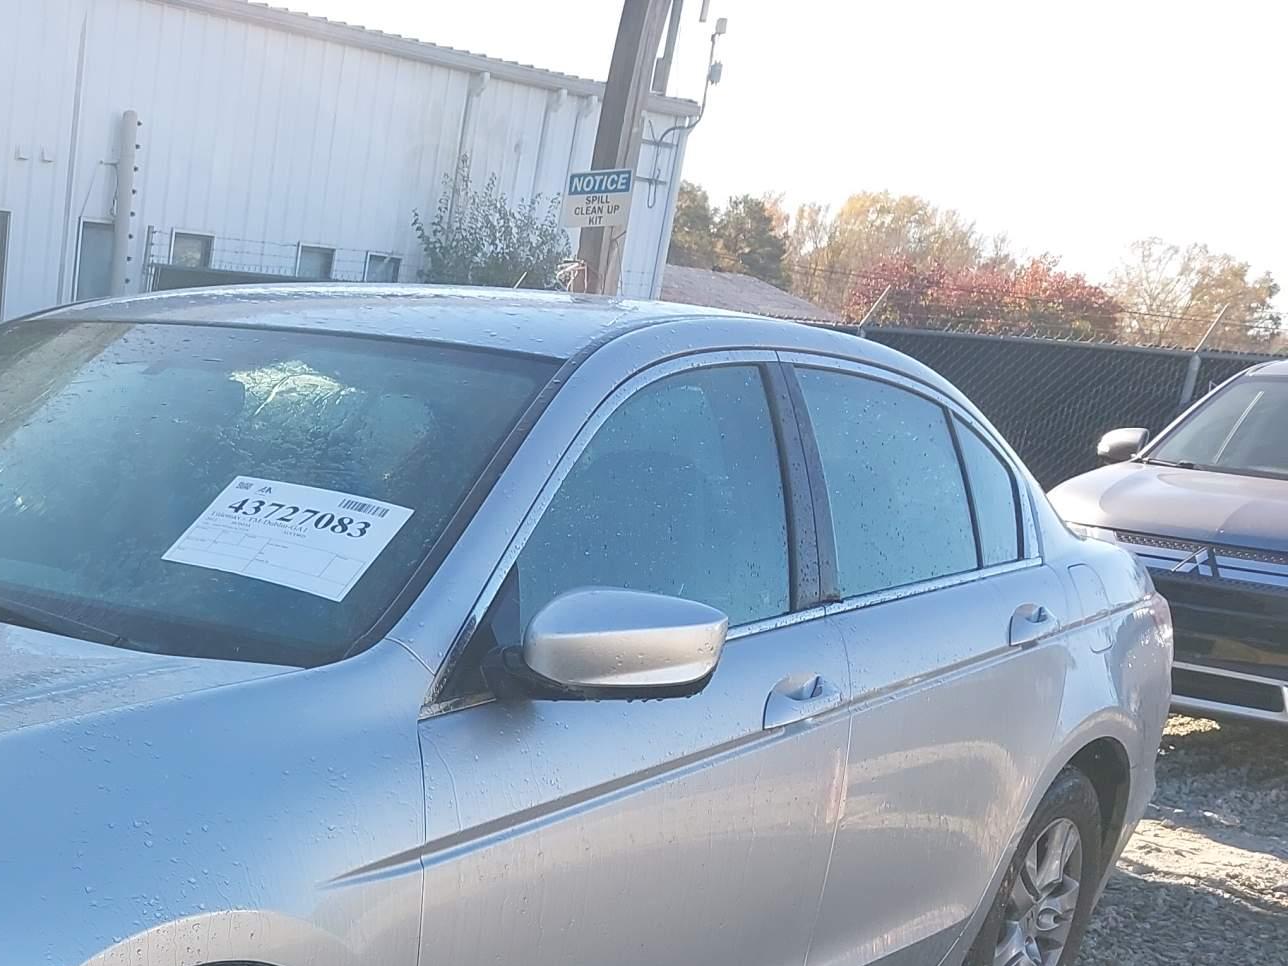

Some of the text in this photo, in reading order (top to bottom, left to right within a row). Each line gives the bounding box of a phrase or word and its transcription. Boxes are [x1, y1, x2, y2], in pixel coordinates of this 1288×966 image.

[571, 174, 628, 192] NOTICE
[585, 195, 610, 205] SPILL
[574, 205, 620, 216] CLEAN UP
[588, 215, 603, 225] KIT
[228, 497, 372, 539] 43727083
